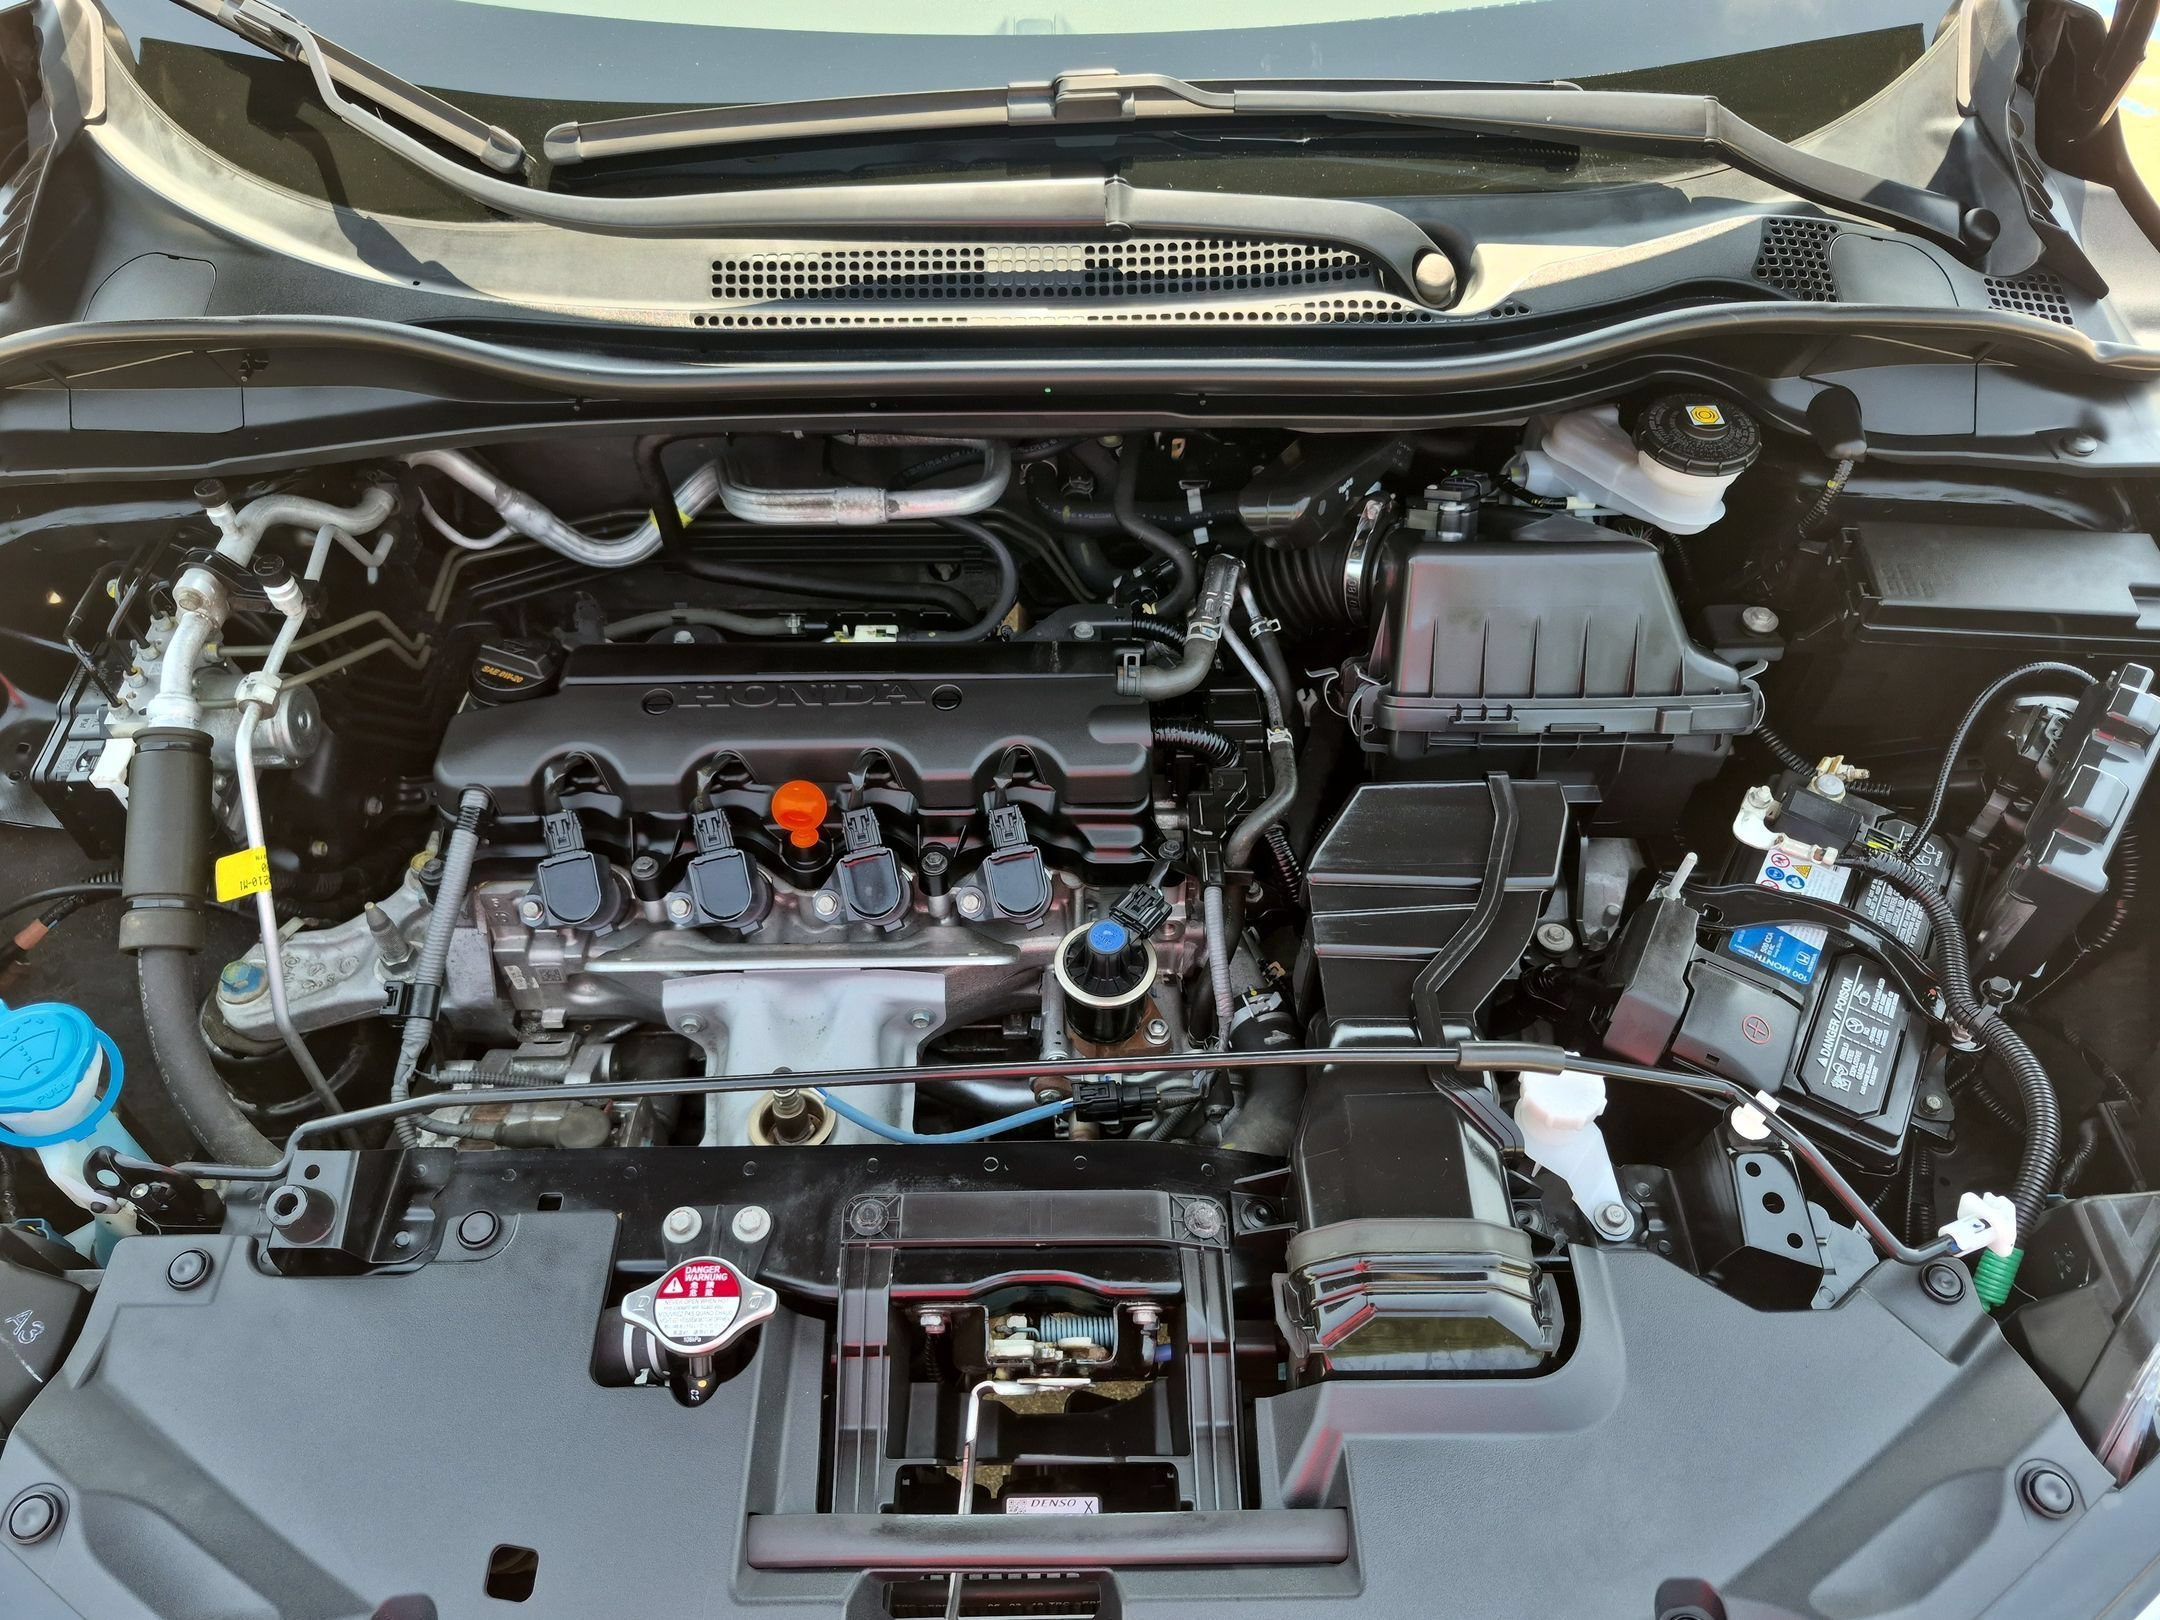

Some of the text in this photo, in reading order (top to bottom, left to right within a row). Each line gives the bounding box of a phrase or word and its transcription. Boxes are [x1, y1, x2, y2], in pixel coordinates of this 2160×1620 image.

[678, 684, 926, 708] HONDA
[1754, 953, 1808, 982] 100 MONTH
[684, 1273, 728, 1281] WARNUNG
[685, 1265, 721, 1274] DANGER
[5, 1310, 45, 1344] A3
[1030, 1499, 1077, 1507] DENSO
